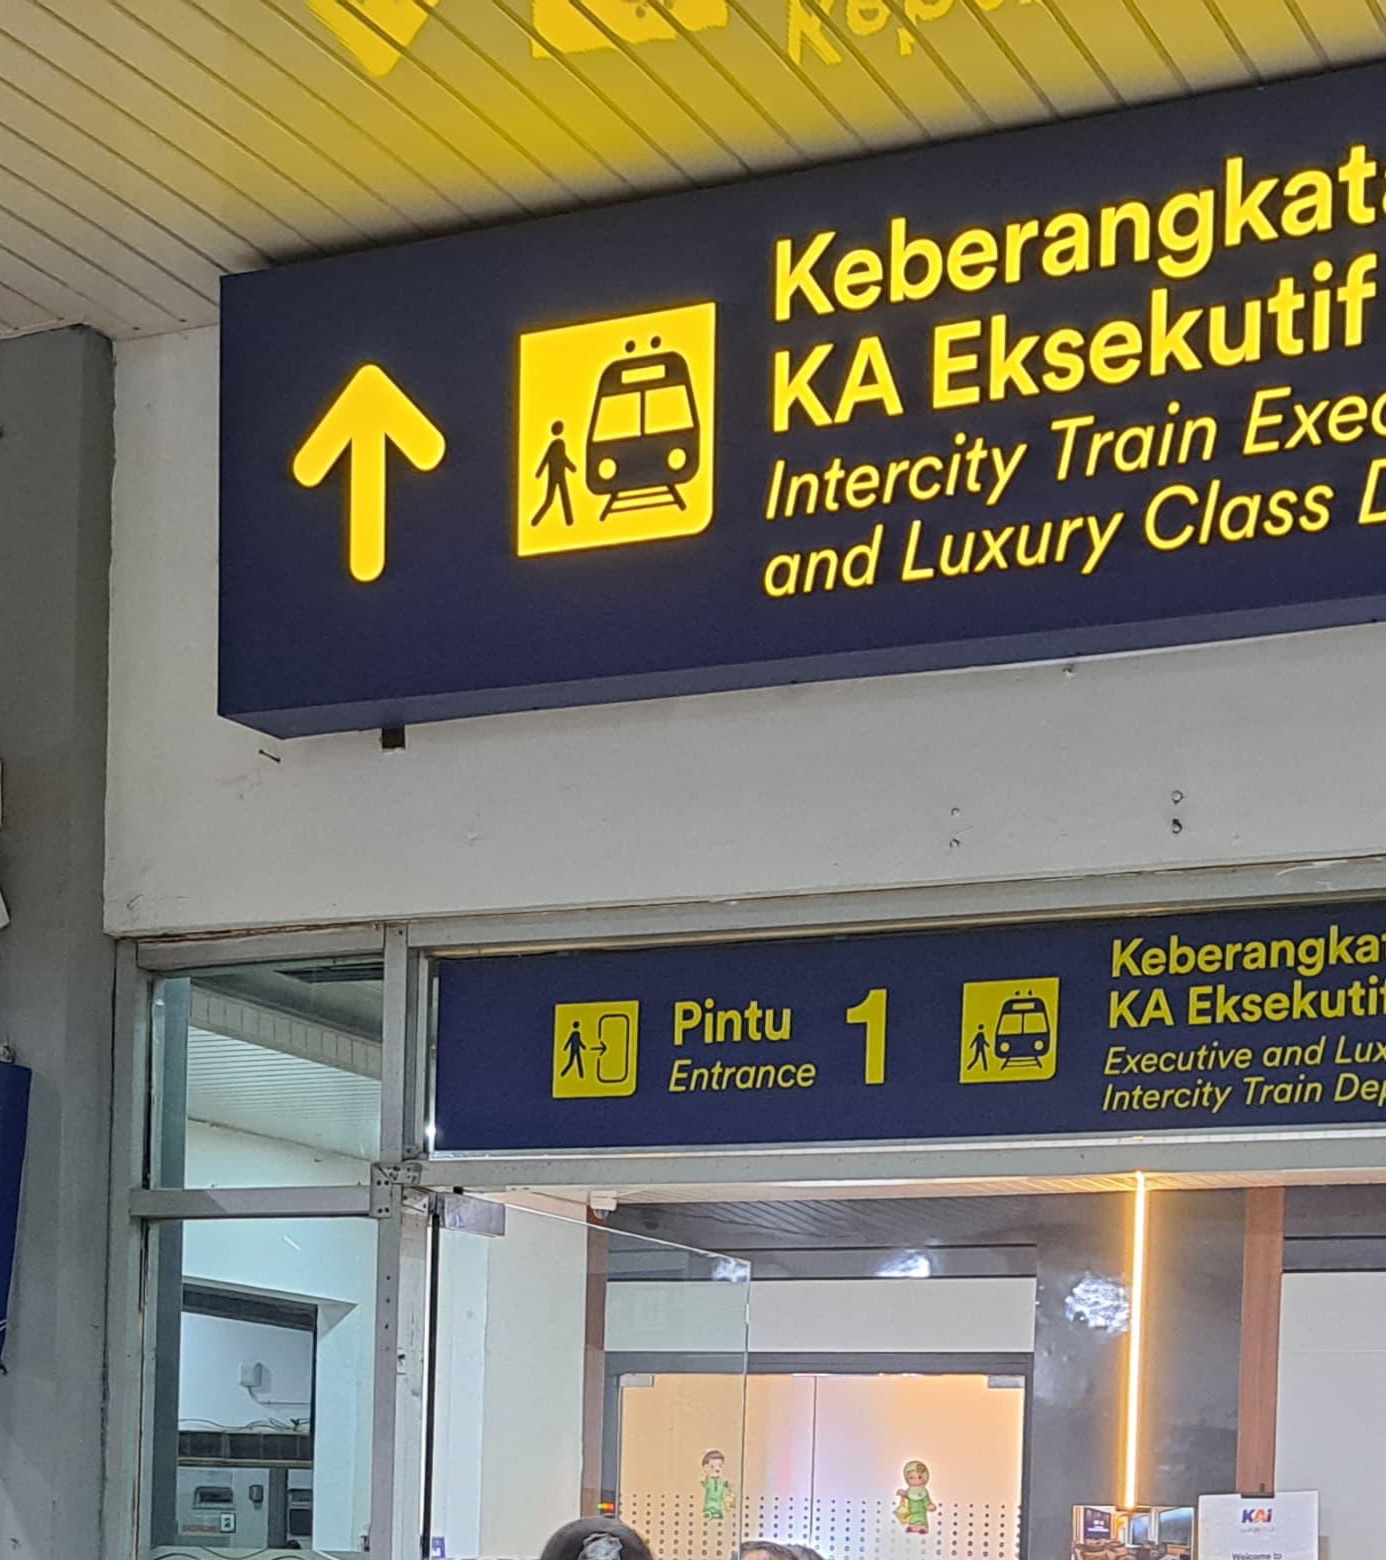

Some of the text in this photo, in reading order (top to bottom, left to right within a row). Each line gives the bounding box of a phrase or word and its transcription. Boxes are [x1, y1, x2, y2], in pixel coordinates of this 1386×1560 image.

[772, 335, 904, 432] KA
[932, 259, 1378, 410] Eksekutif
[765, 433, 1027, 520] Intercity
[1051, 414, 1217, 481] Train
[764, 524, 884, 597] and
[901, 511, 1124, 582] Luxury
[1144, 480, 1334, 550] Class
[673, 998, 791, 1046] Pintu
[1109, 988, 1174, 1029] KA
[846, 988, 887, 1085] 1
[1104, 1040, 1252, 1075] Executive
[1263, 1037, 1324, 1067] and
[669, 1059, 816, 1092] Entrance
[1103, 1081, 1231, 1112] Intercity
[1243, 1075, 1323, 1105] Train
[1232, 1551, 1283, 1560] Welcome to
